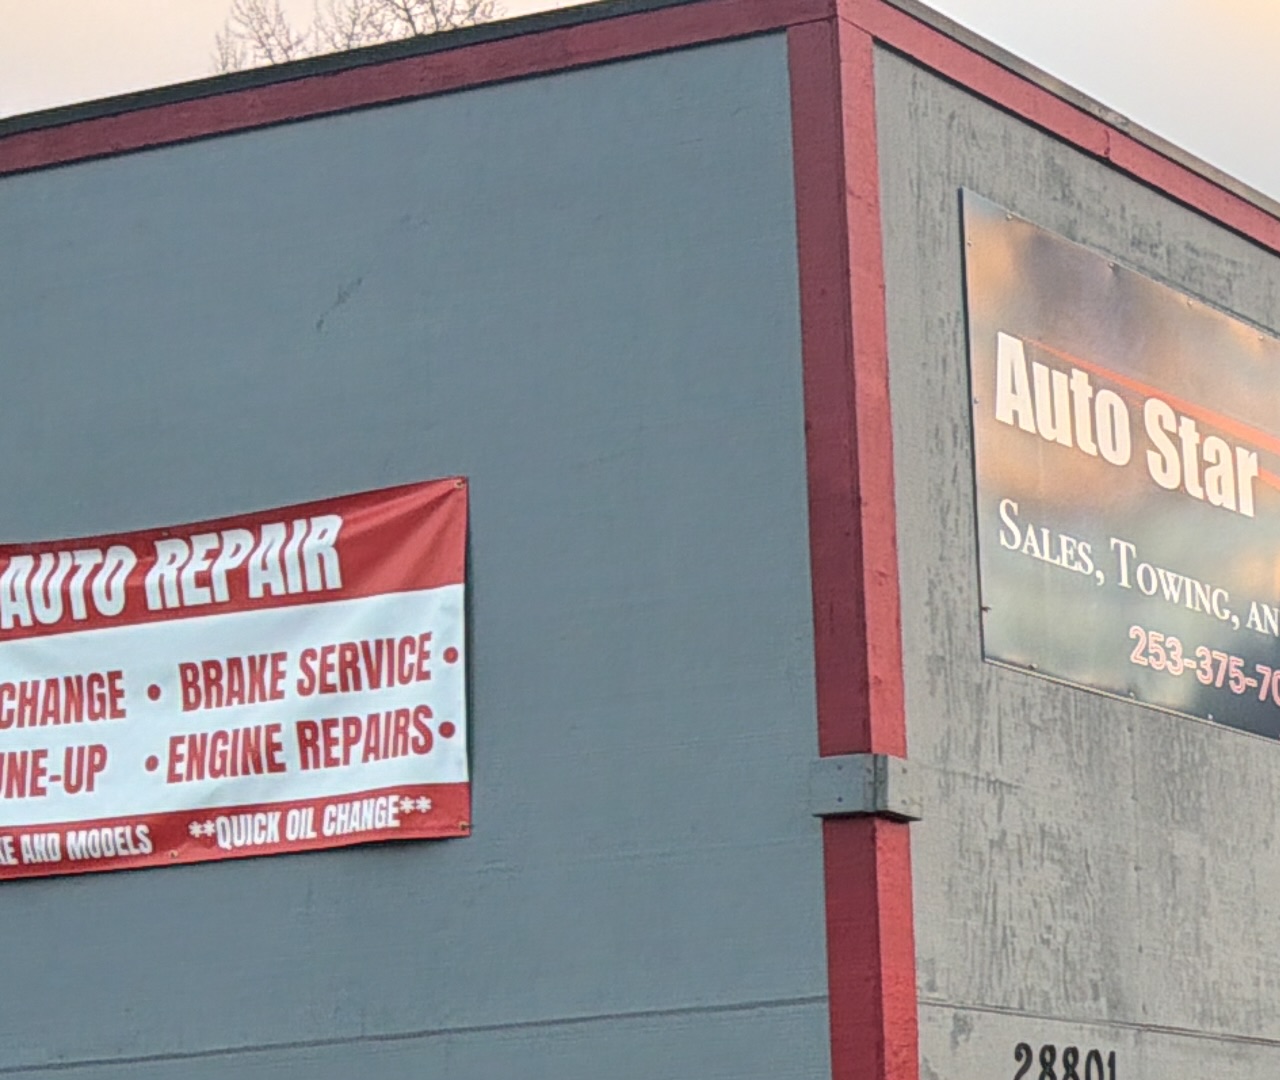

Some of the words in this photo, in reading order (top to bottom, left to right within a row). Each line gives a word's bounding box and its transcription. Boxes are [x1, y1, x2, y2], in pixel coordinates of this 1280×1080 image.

[995, 331, 1131, 467] Auto
[1144, 397, 1259, 518] Star
[0, 545, 138, 630] AUTO
[145, 514, 344, 611] REPAIR
[0, 670, 127, 730] CHANGE
[178, 652, 287, 712] BRAKE
[296, 631, 433, 697] SERVICE
[0, 743, 108, 799] NE-UP
[166, 723, 287, 783] ENGINE
[296, 704, 434, 770] REPAIRS
[20, 832, 61, 865] AND
[66, 824, 153, 861] MODELS
[285, 806, 317, 841] OIL
